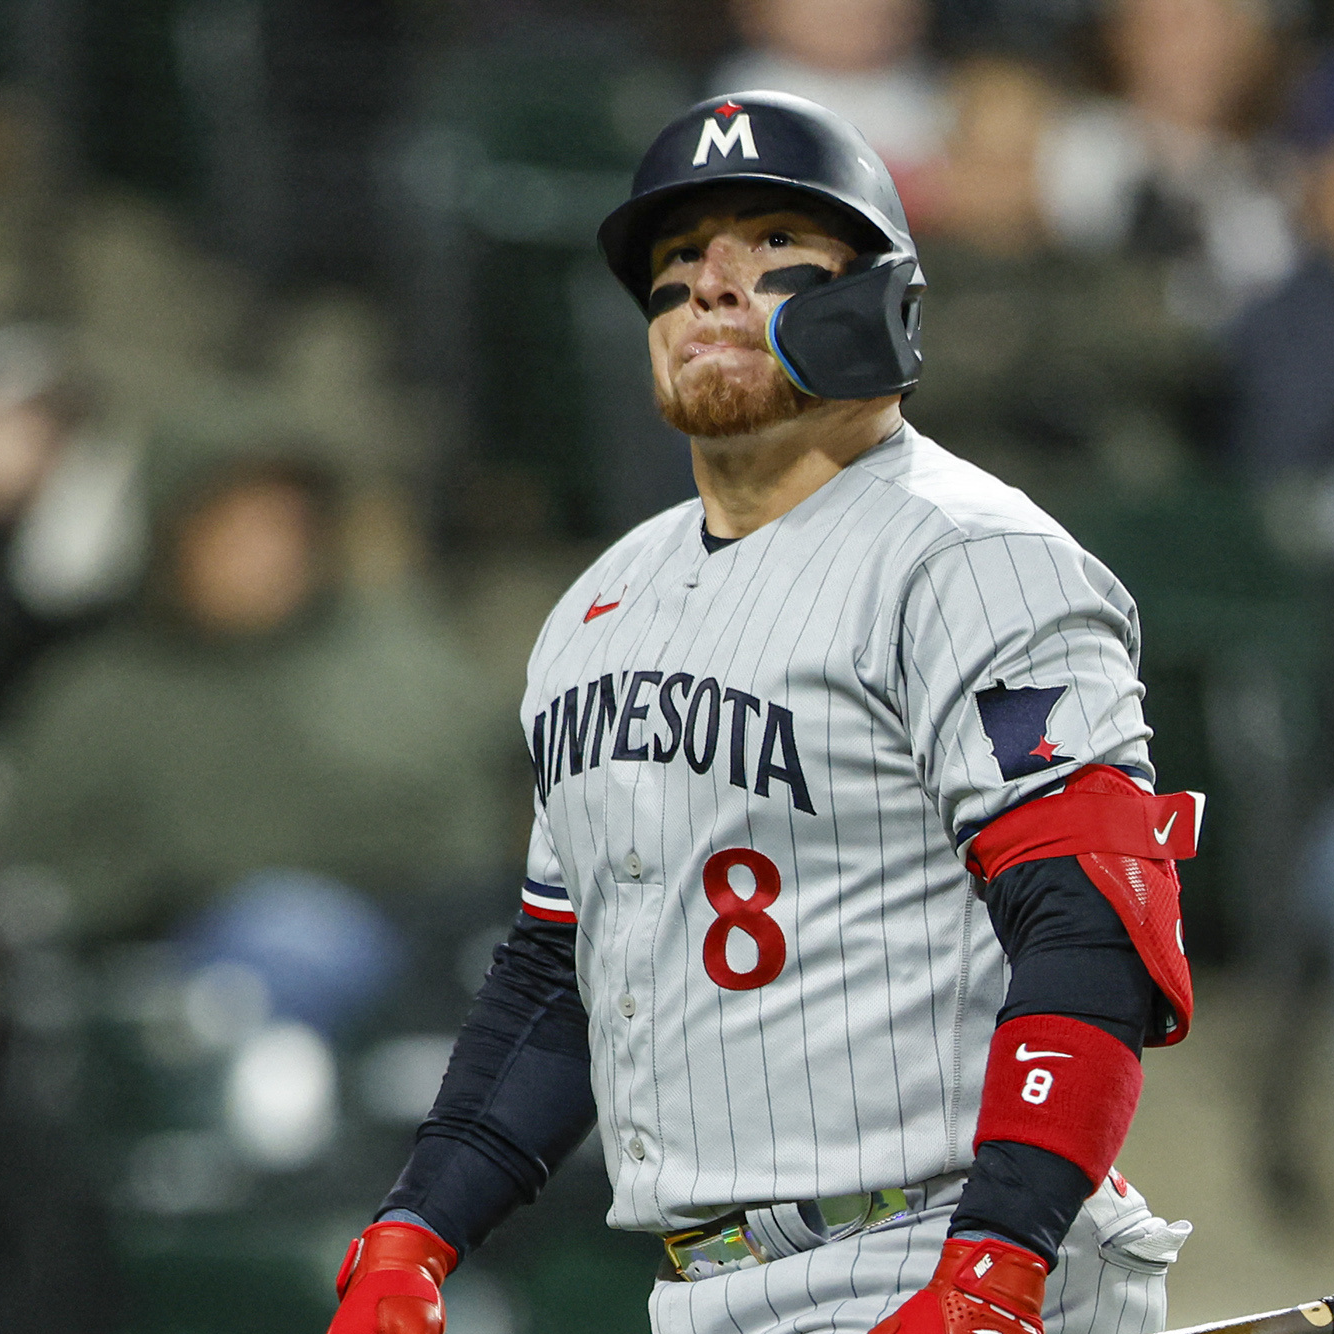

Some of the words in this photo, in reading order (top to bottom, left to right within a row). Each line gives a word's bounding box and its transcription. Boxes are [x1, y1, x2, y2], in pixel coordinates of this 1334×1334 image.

[692, 112, 760, 168] M
[702, 848, 786, 990] 8
[1020, 1067, 1055, 1105] 8
[972, 1252, 994, 1279] NIKE
